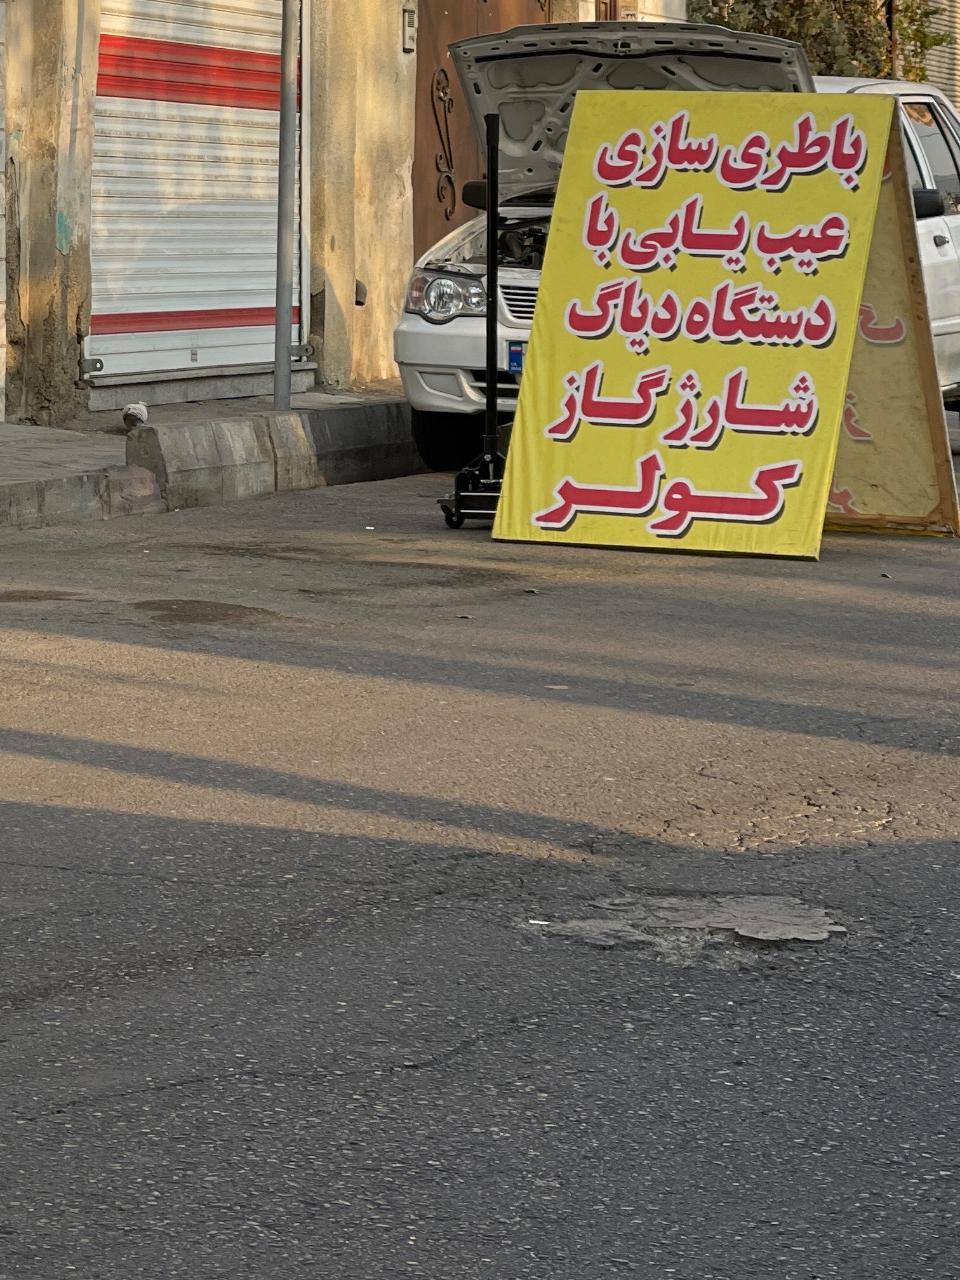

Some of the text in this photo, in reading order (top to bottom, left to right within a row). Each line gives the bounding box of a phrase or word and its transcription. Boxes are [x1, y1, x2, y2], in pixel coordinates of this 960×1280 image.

[595, 109, 867, 191] باطری سازی
[582, 192, 849, 274] عیب یابی با
[565, 277, 682, 352] دیاگ
[682, 278, 837, 345] دستگاه
[545, 360, 670, 440] گاز
[660, 365, 819, 447] شارژ
[533, 449, 802, 537] کولر
